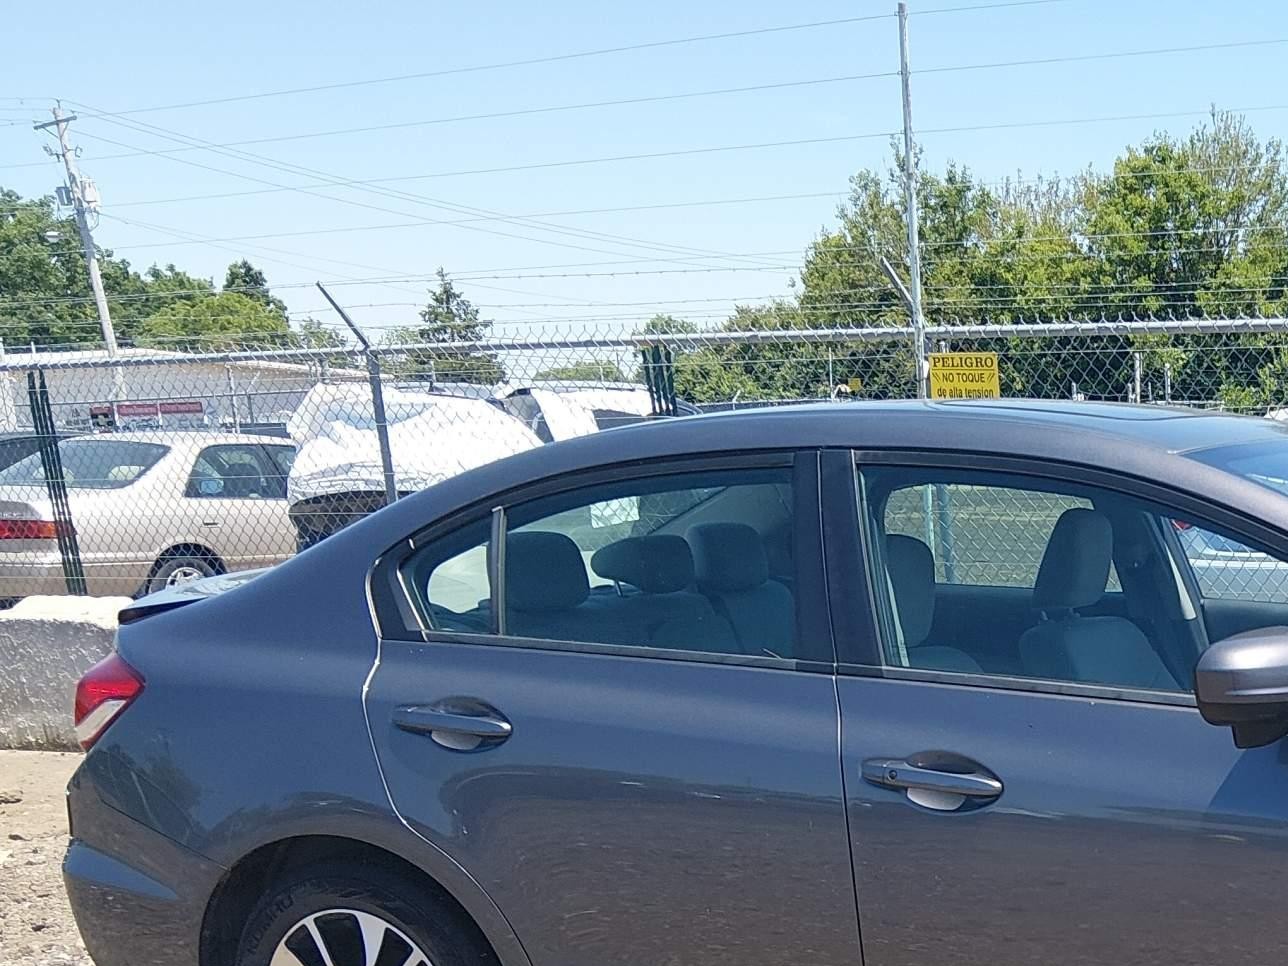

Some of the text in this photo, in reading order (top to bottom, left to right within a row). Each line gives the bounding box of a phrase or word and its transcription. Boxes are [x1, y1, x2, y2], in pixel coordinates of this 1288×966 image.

[932, 356, 994, 368] PELIGRO
[942, 372, 985, 383] NO TOQUE
[937, 386, 994, 398] de alta tension
